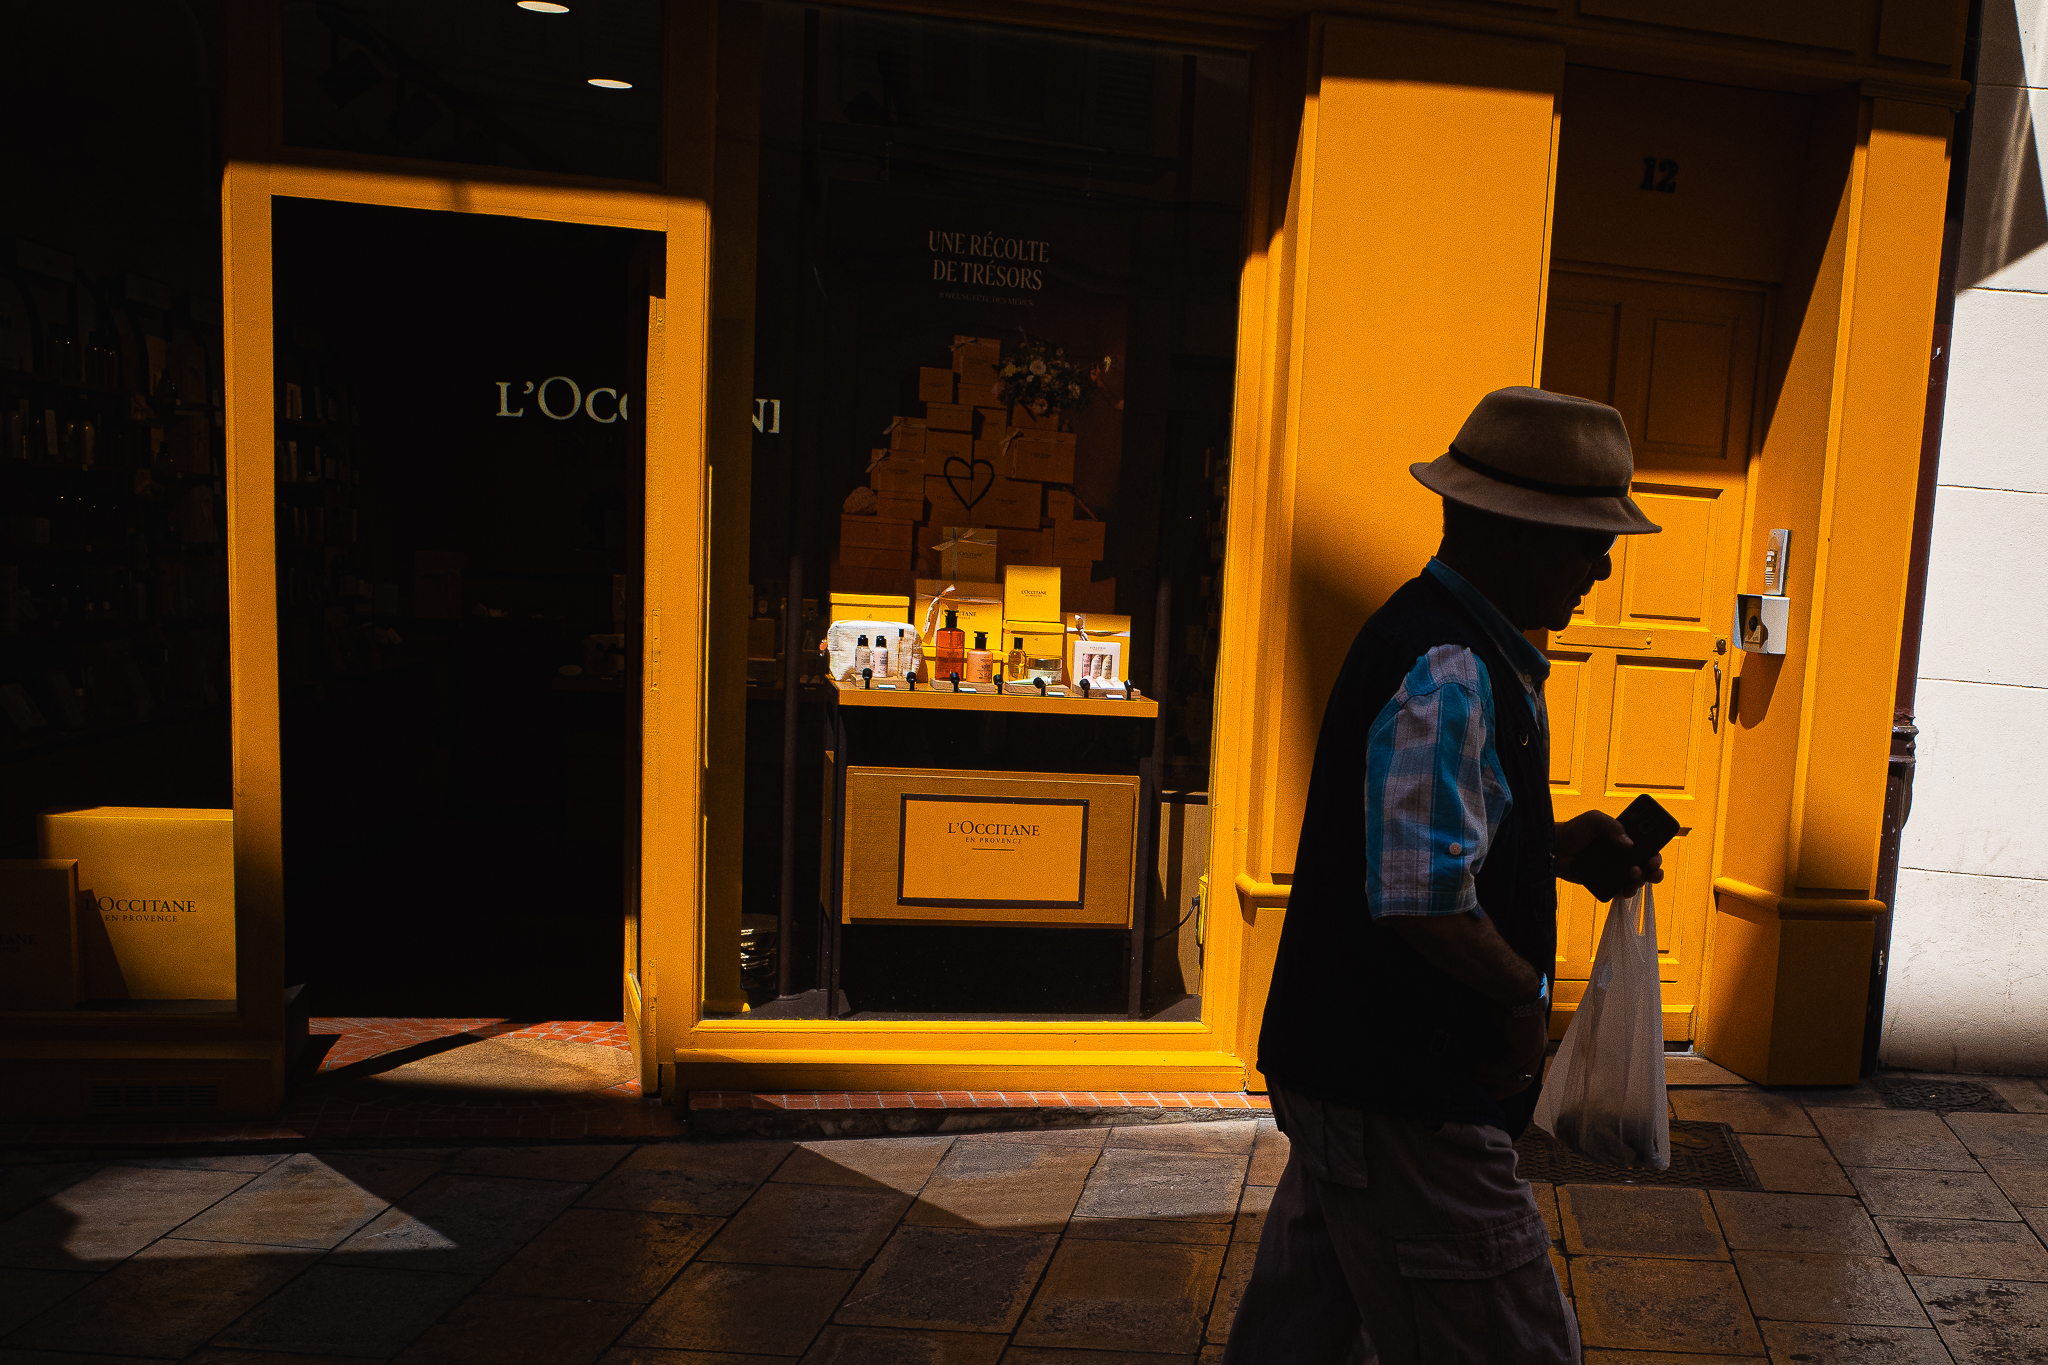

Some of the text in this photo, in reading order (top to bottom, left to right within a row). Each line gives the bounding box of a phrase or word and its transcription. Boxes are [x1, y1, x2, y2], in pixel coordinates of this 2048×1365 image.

[1639, 156, 1679, 193] 12
[928, 229, 1050, 263] UNE RÉCOLTE
[932, 258, 1043, 291] DE TRÉSORS
[947, 820, 1040, 837] L'OCCITANE
[85, 896, 197, 913] L'OCCITANE
[105, 914, 178, 923] EN PROVENCE
